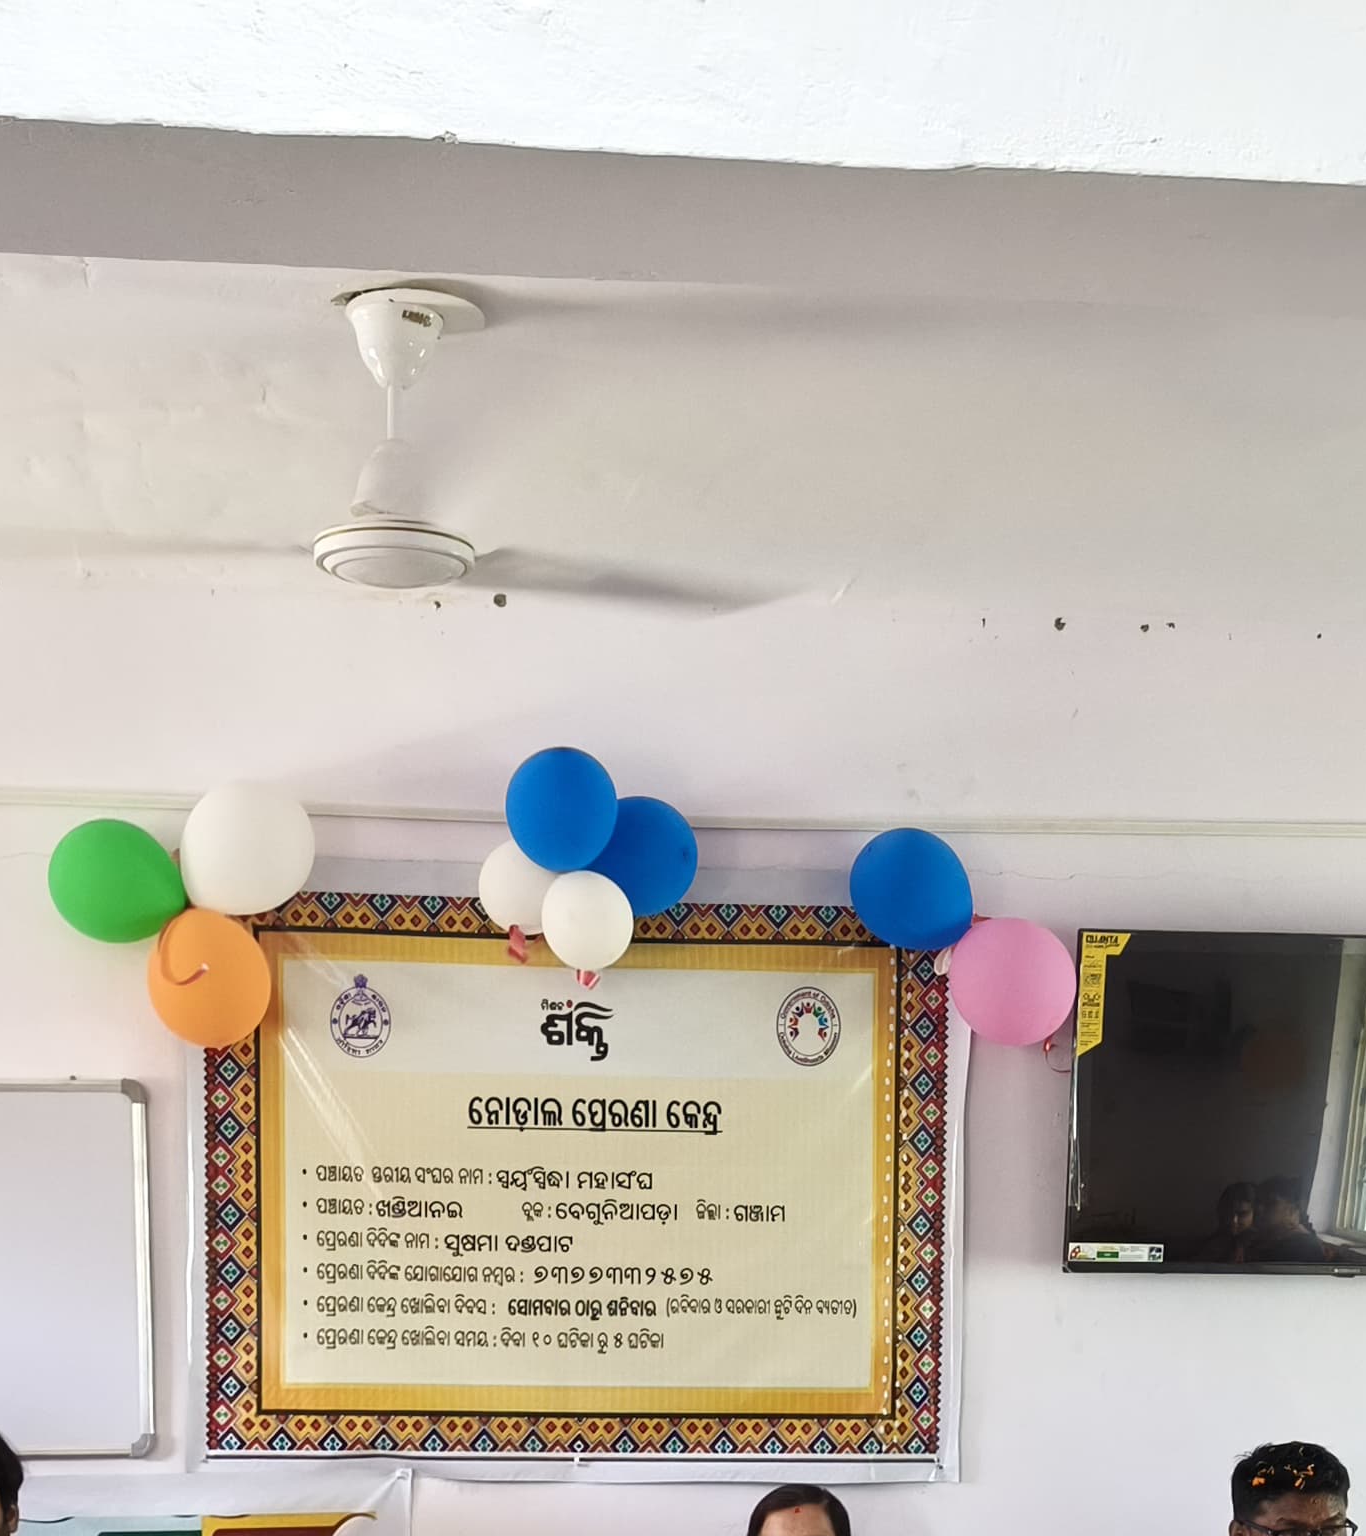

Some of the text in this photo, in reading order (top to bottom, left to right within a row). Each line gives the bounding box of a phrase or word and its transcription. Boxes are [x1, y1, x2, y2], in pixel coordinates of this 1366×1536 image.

[572, 1098, 656, 1132] ପ୍ରେରଣା
[667, 1100, 723, 1135] କେନ୍ଦ୍ର
[578, 1170, 654, 1190] ମହାସଂଘ
[316, 1230, 363, 1251] ପ୍ରେରଣା
[444, 1234, 498, 1257] ସୁଷମା
[316, 1262, 363, 1284] ପ୍ରେରଣା
[404, 1265, 478, 1283] ଯୋଗାଯୋଗ
[316, 1295, 364, 1317] ପ୍ରେରଣା
[508, 1298, 571, 1317] ସୋମବାର
[316, 1328, 364, 1350] ପ୍ରେରଣା
